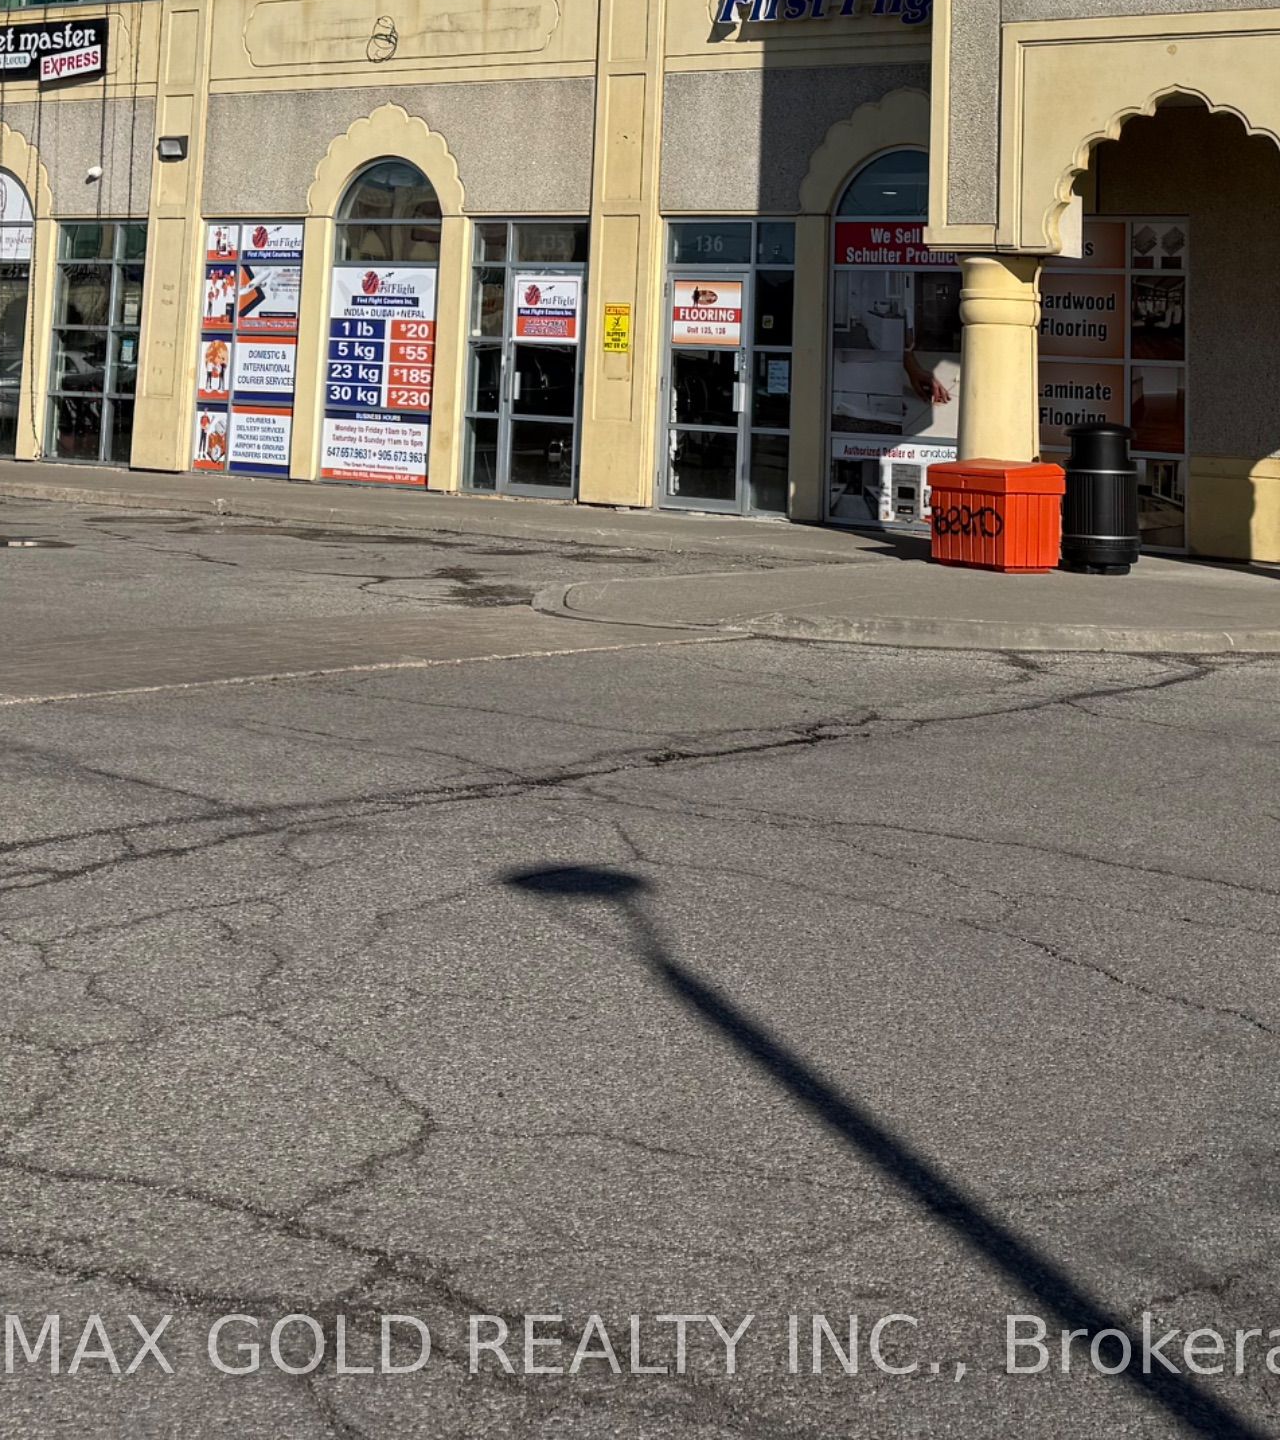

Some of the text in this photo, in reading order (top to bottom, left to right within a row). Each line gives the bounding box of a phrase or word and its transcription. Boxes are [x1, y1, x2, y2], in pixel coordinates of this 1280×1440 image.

[19, 23, 96, 60] master
[43, 51, 99, 76] EXPRESS
[696, 235, 723, 252] 136
[870, 227, 920, 244] We Sell
[846, 247, 902, 263] Schulter
[1040, 292, 1115, 310] ardwood
[679, 308, 735, 322] FLOORING
[342, 322, 374, 336] 1 lb
[400, 324, 429, 338] $20
[1040, 318, 1107, 342] Flooring
[248, 350, 280, 359] DOMESTIC
[338, 342, 375, 360] 5 kg
[399, 346, 428, 360] $55
[243, 363, 291, 373] INTERNATIONAL
[331, 364, 379, 383] 23 kg
[393, 368, 431, 384] $185
[330, 386, 378, 405] 30 kg
[391, 390, 430, 407] $230
[1039, 381, 1111, 401] aminate
[882, 447, 905, 458] Dealer
[907, 449, 915, 459] of
